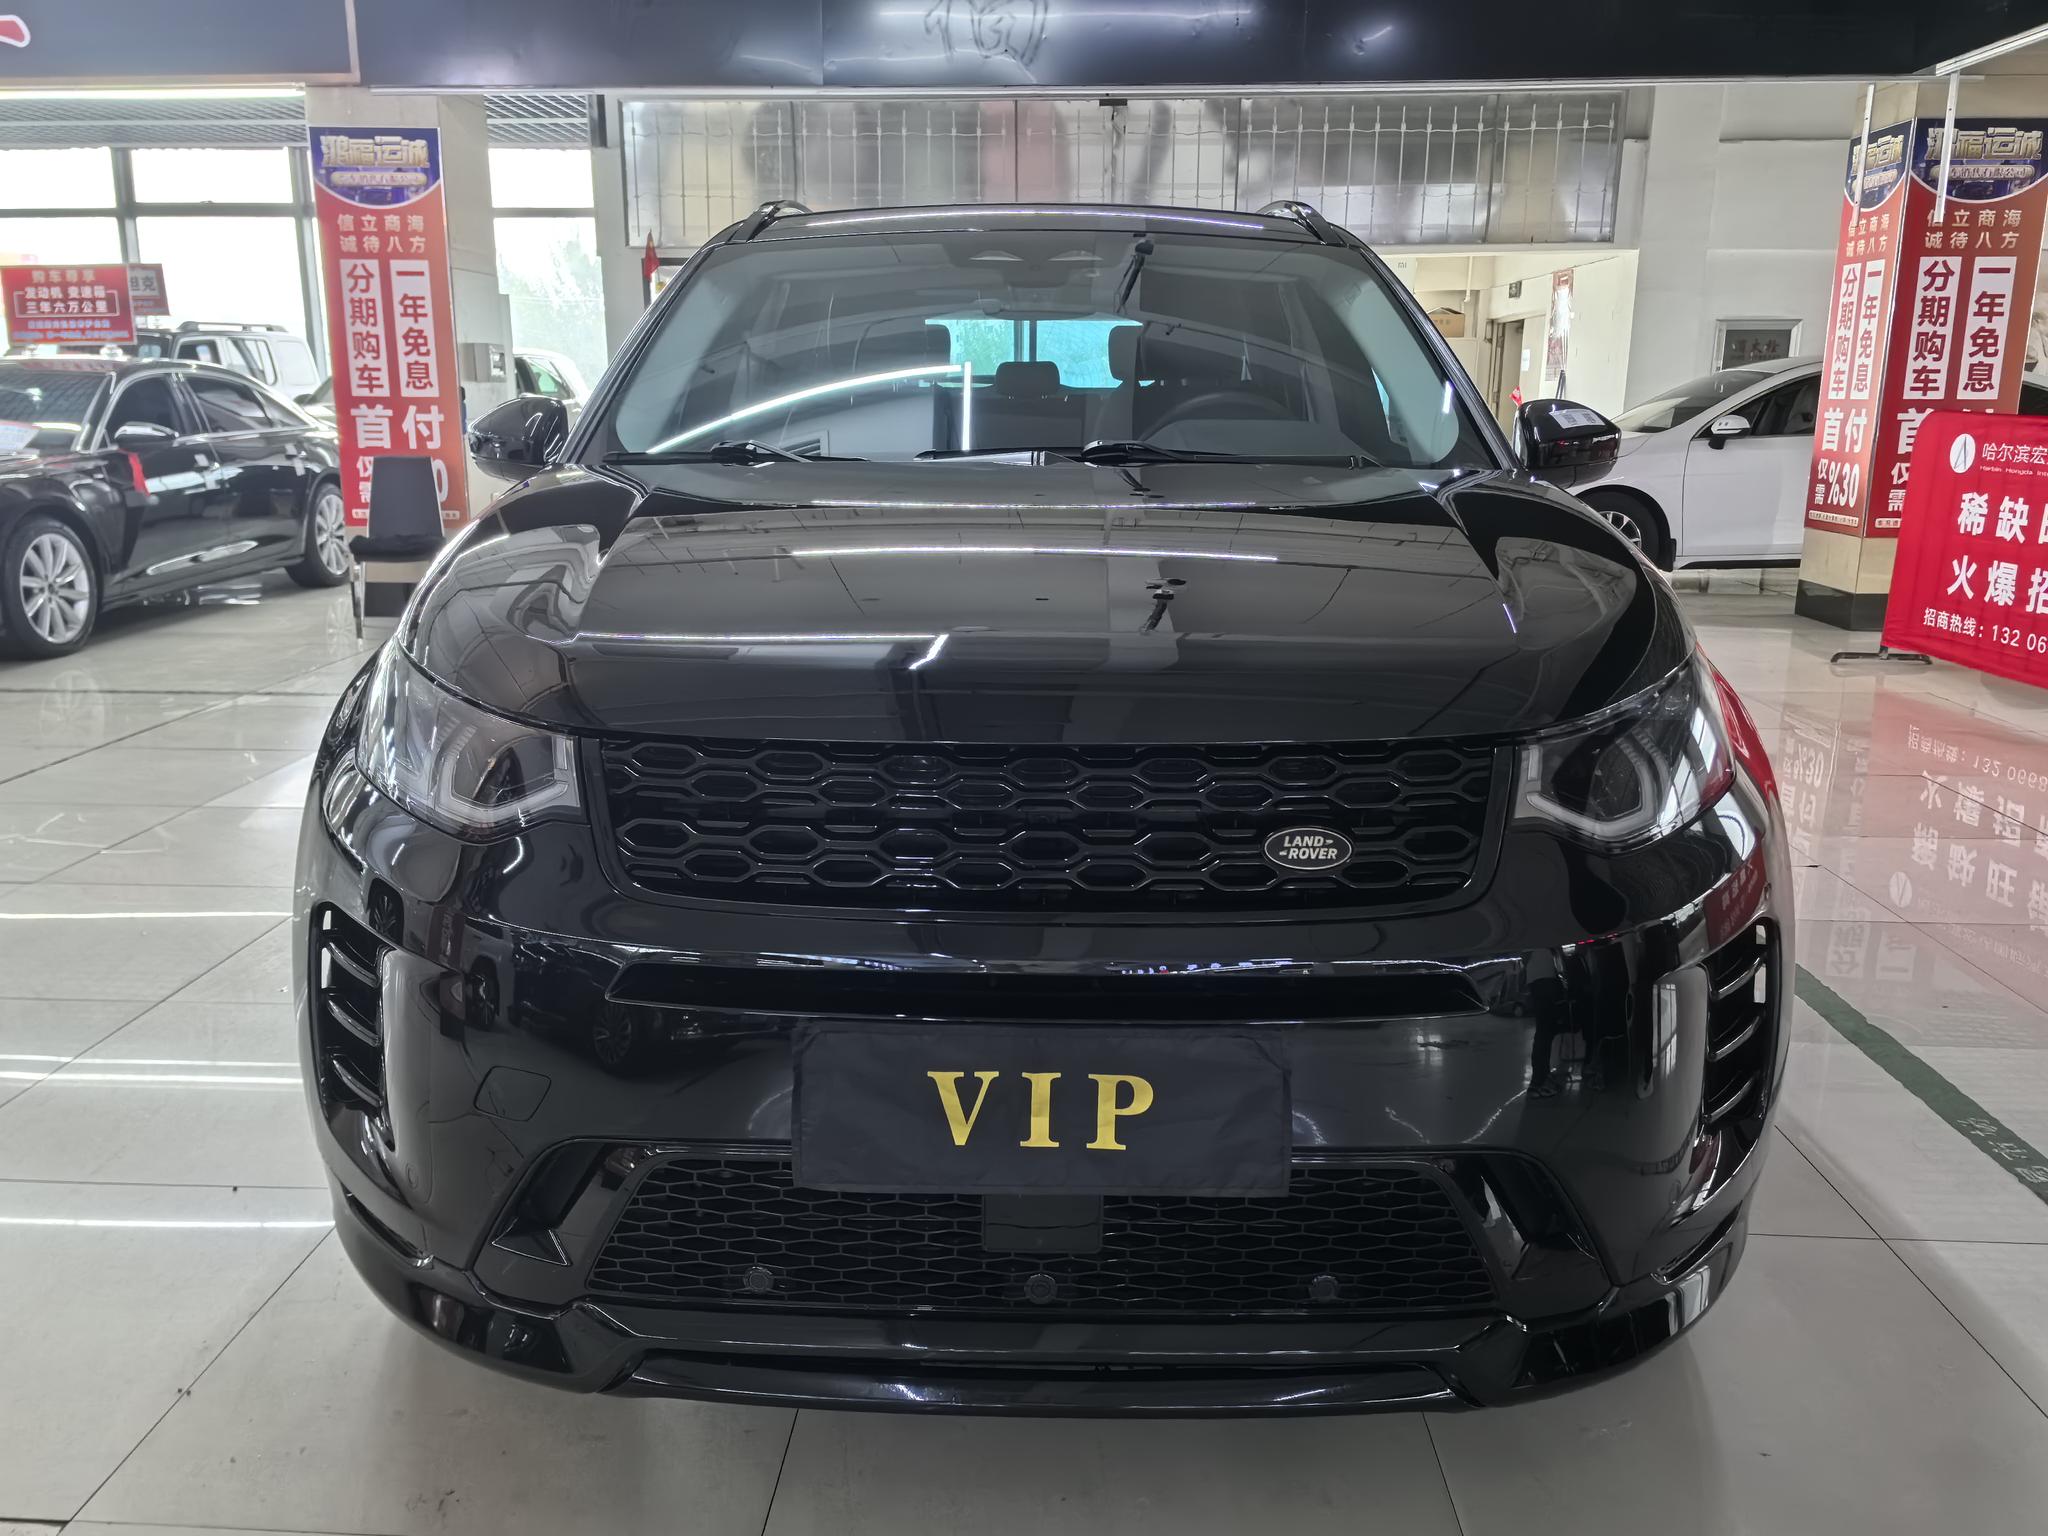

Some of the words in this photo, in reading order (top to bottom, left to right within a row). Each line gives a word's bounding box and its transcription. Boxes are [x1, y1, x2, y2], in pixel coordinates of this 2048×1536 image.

[337, 213, 424, 232] 信立商海
[1924, 231, 2020, 249] 诚待八方
[340, 235, 426, 253] 诚待八方
[1846, 235, 1888, 258] 诚待八方
[25, 301, 108, 314] 三年六万公里
[346, 263, 384, 393] 分期购车
[396, 270, 434, 390] 一年免息
[1832, 267, 1858, 397] 分期购车
[1854, 269, 1882, 393] 一年免息
[1910, 260, 1955, 397] 分期购车
[1963, 267, 2011, 393] 一年免息
[350, 404, 444, 450] 首付
[1822, 407, 1867, 453] 首付
[1982, 442, 2048, 465] 哈尔滨宏
[1992, 624, 2020, 647] 132
[2026, 633, 2048, 654] 06
[1283, 835, 1324, 847] LAND
[1288, 848, 1338, 859] ROVER
[926, 1070, 1154, 1151] VIP
